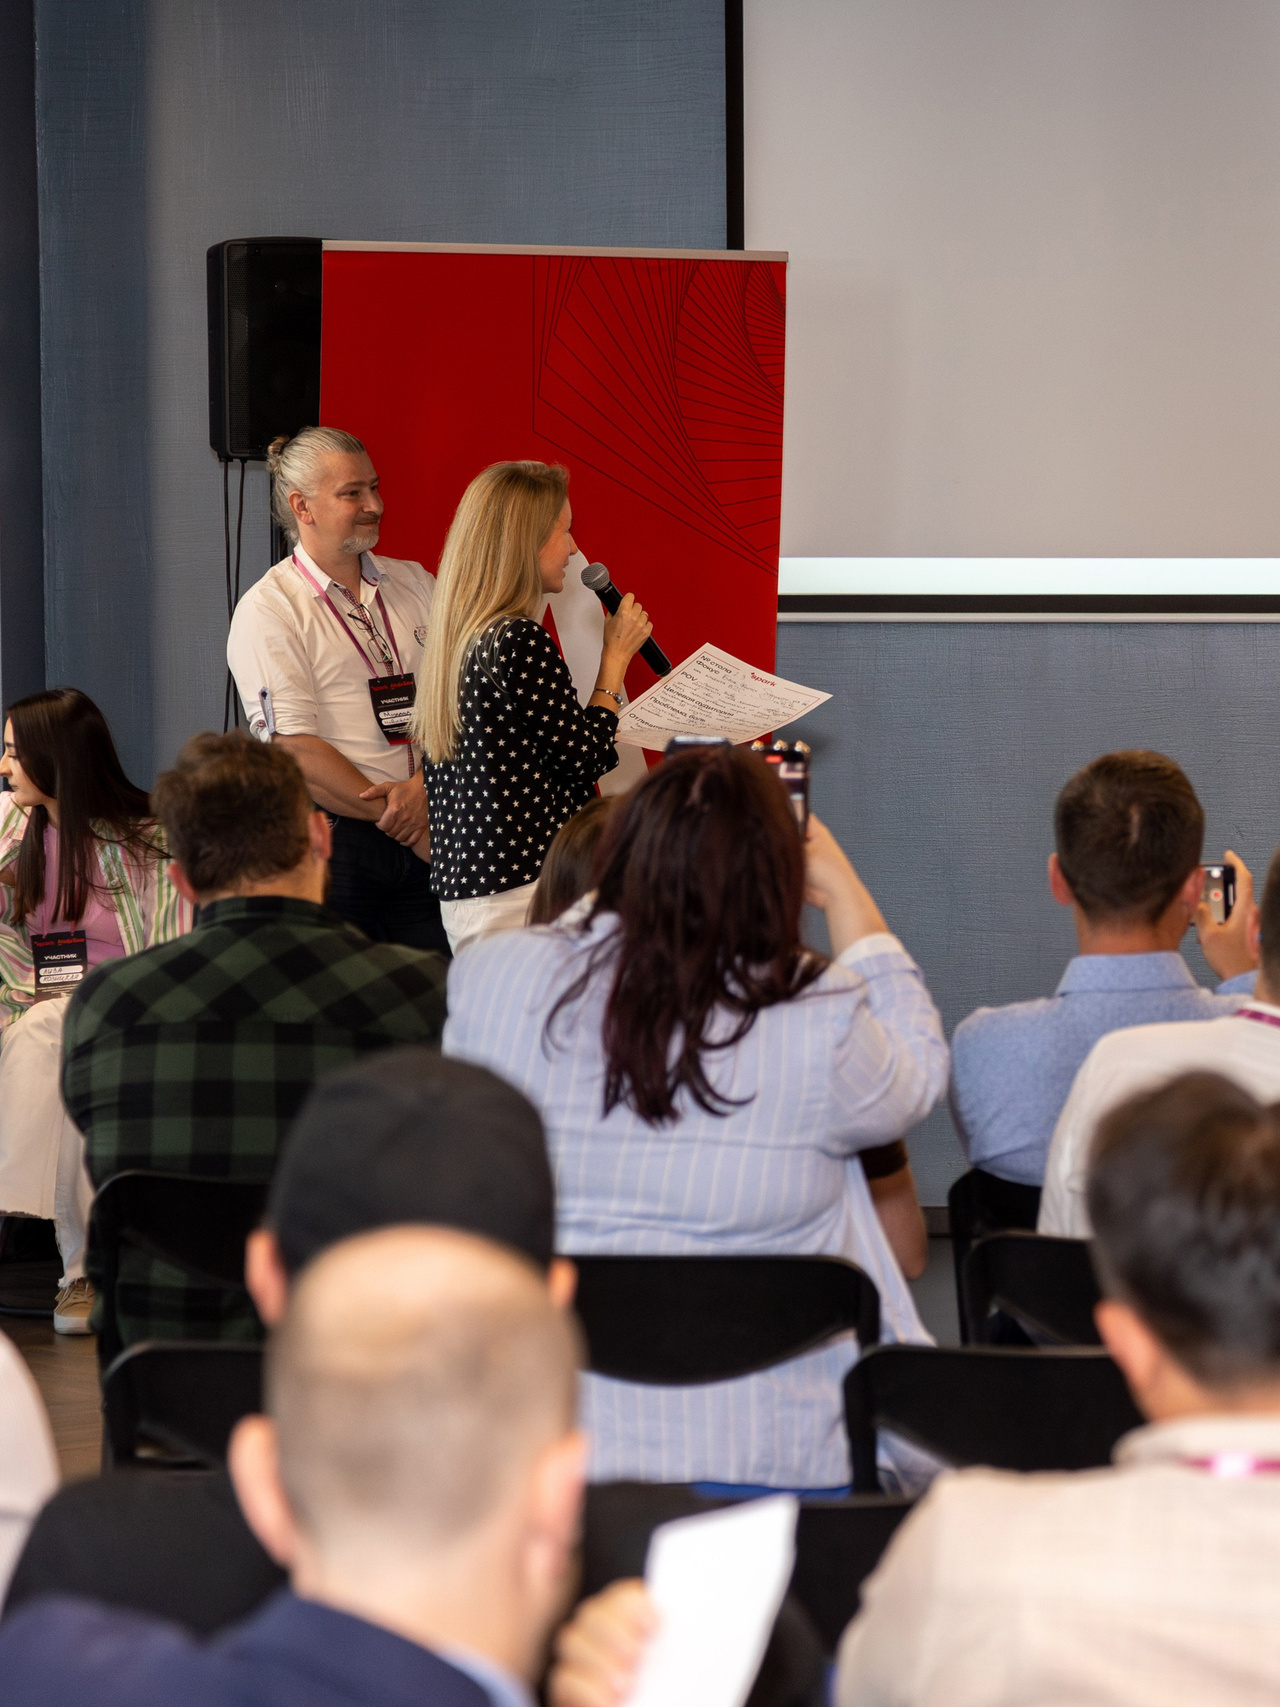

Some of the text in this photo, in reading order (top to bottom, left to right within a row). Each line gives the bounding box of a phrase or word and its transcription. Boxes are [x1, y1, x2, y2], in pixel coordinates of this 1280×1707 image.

[696, 660, 720, 675] Фокус
[710, 661, 732, 674] стола
[680, 671, 698, 682] POV
[751, 673, 777, 688] spark
[381, 696, 409, 704] УЧАСТНИК
[663, 684, 696, 703] Целевая
[695, 700, 735, 717] аудитория
